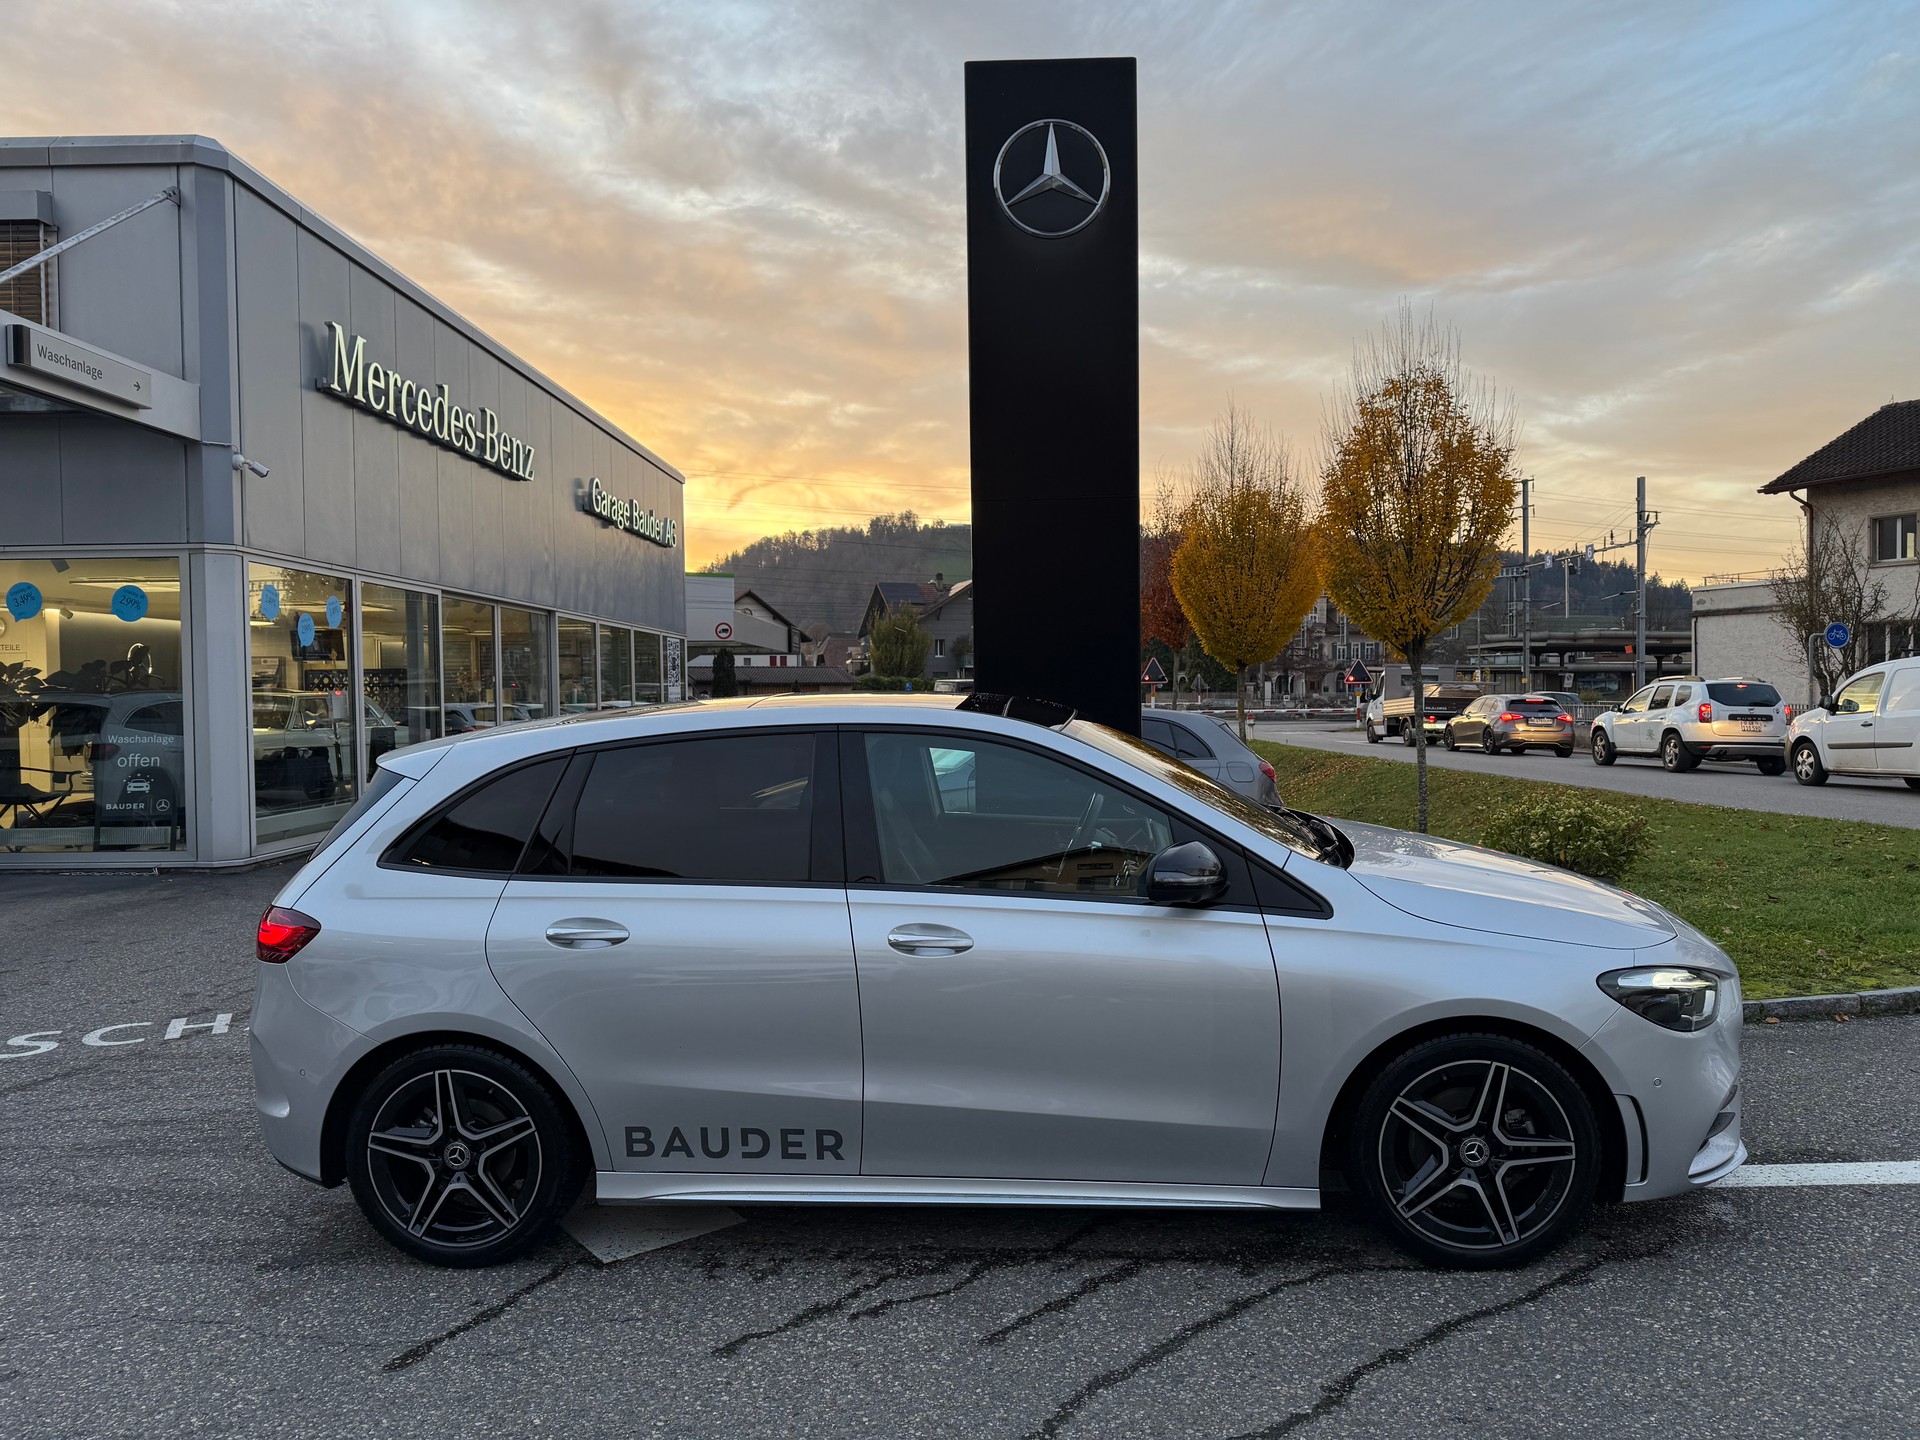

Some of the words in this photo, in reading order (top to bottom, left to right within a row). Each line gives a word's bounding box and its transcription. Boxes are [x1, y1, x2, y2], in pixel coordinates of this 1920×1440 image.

[37, 344, 102, 380] Waschanlage
[324, 320, 536, 482] Mercedes-Benz
[590, 477, 630, 530] Garage
[632, 498, 664, 542] Bauder
[665, 517, 677, 548] AG
[13, 592, 35, 607] 3.49%
[108, 735, 174, 745] Waschanlage
[117, 753, 160, 767] offen
[0, 1013, 250, 1059] SCH
[625, 1126, 845, 1161] BAUDER
